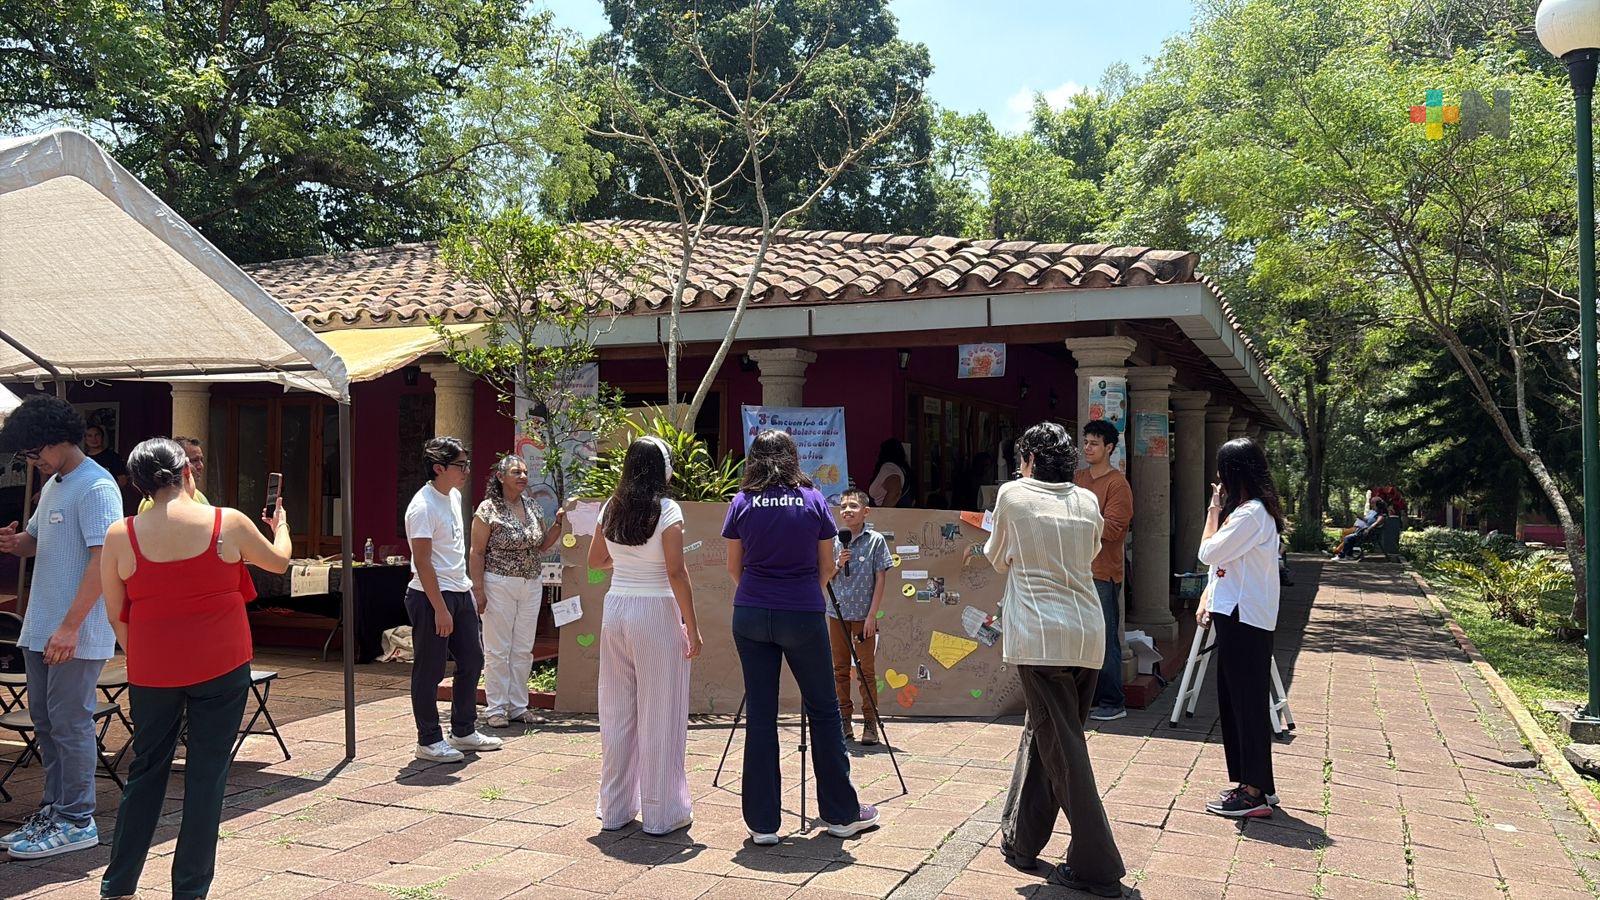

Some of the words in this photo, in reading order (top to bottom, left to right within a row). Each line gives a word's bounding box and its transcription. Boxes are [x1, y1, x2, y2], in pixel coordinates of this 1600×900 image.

[771, 414, 815, 426] Encuentro
[818, 417, 828, 426] de
[752, 494, 804, 508] Kendra
